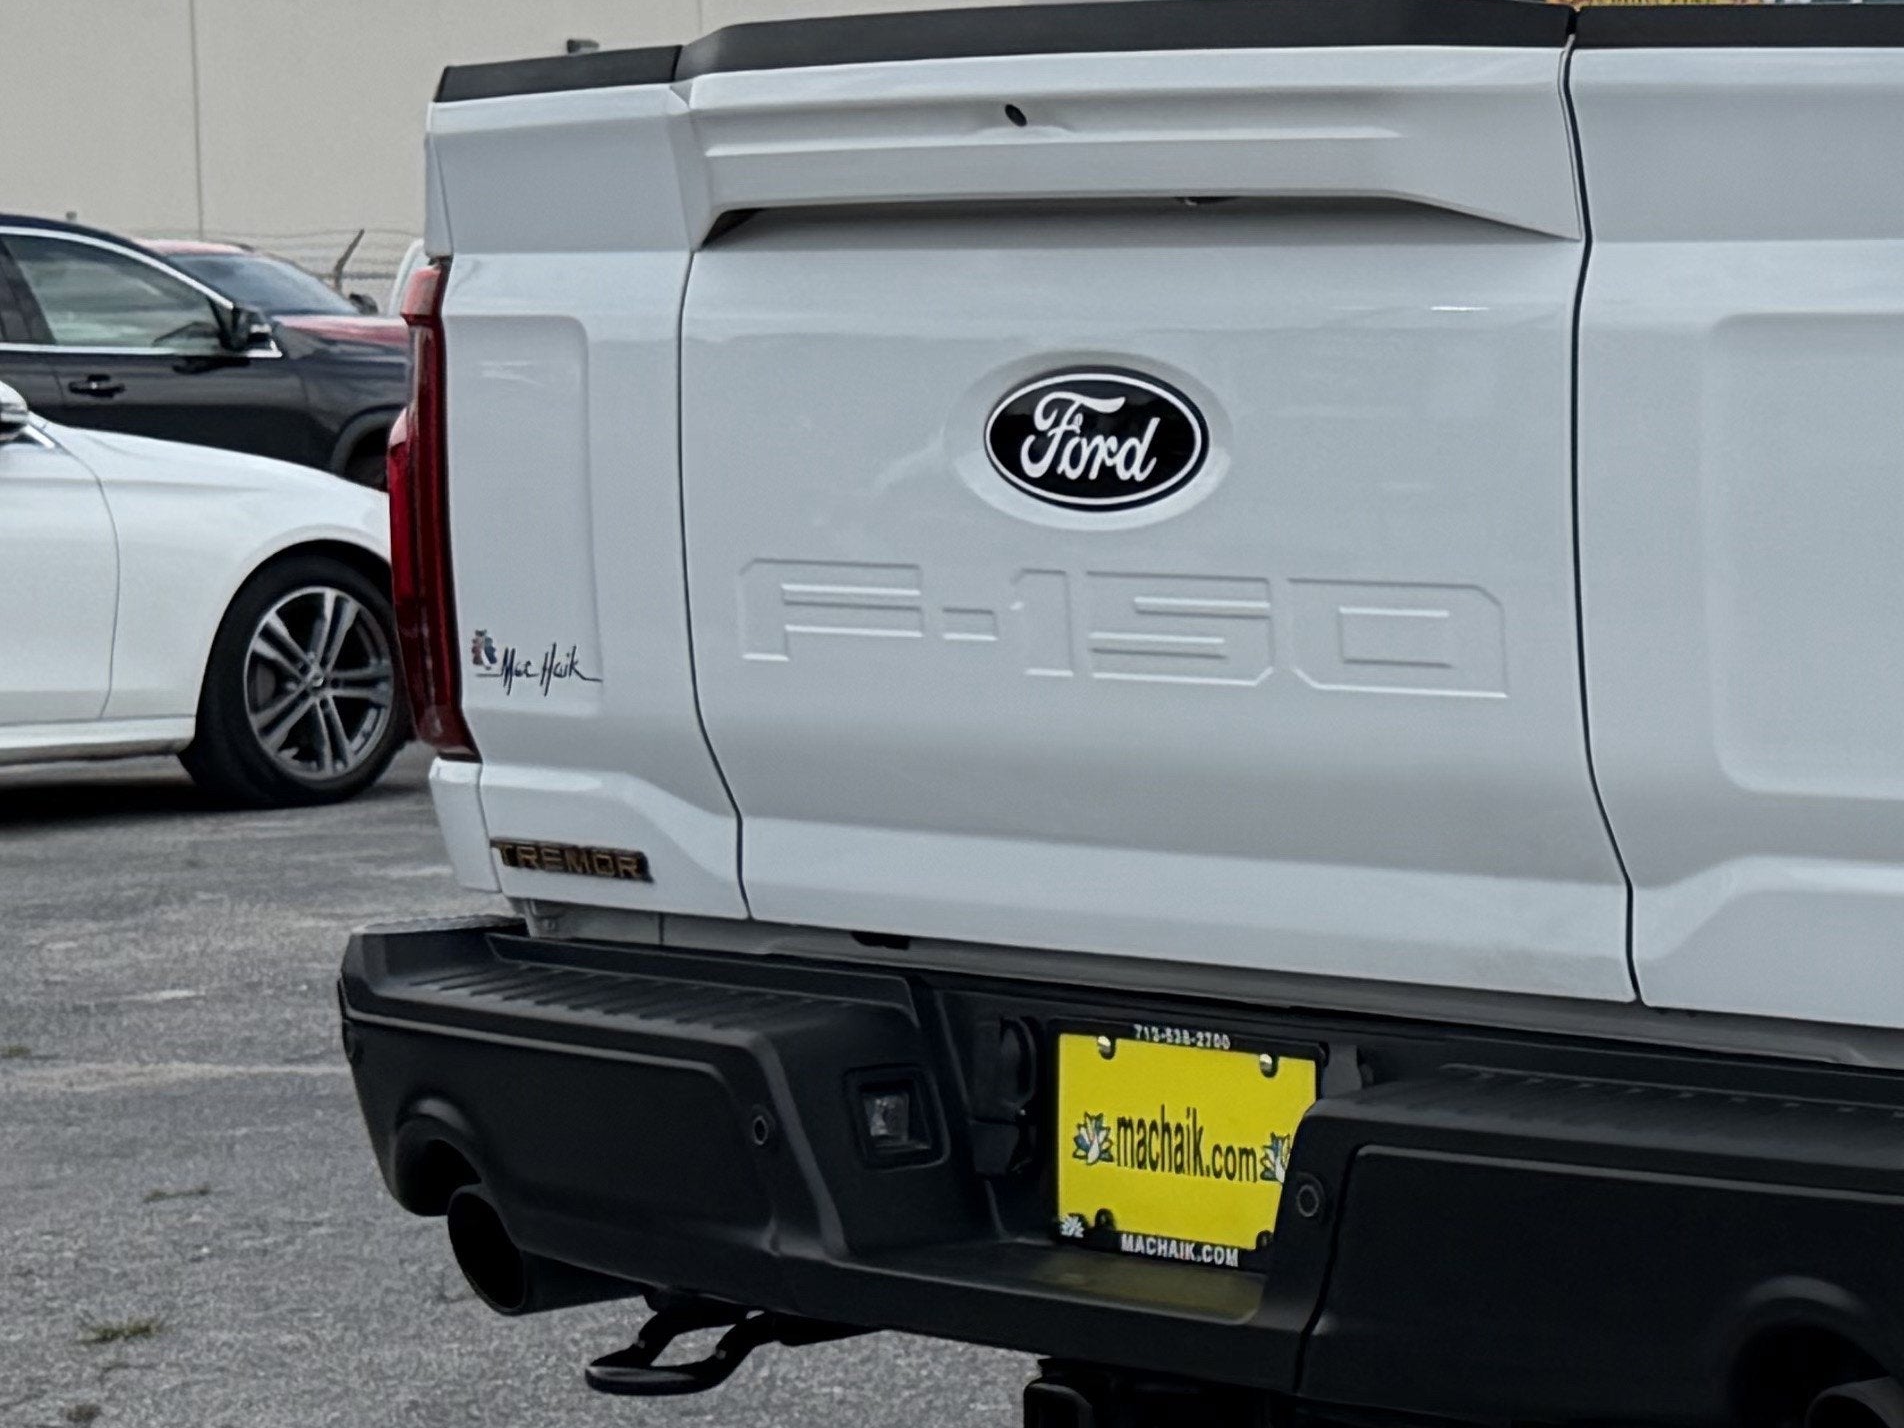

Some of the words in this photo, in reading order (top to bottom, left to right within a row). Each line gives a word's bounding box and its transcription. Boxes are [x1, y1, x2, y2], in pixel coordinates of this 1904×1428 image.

[1020, 390, 1161, 482] Ford
[740, 556, 1507, 698] F-150
[492, 838, 651, 882] TREMOR
[1116, 1103, 1258, 1184] machaik.com
[1120, 1232, 1240, 1267] MACHAIK.COM
